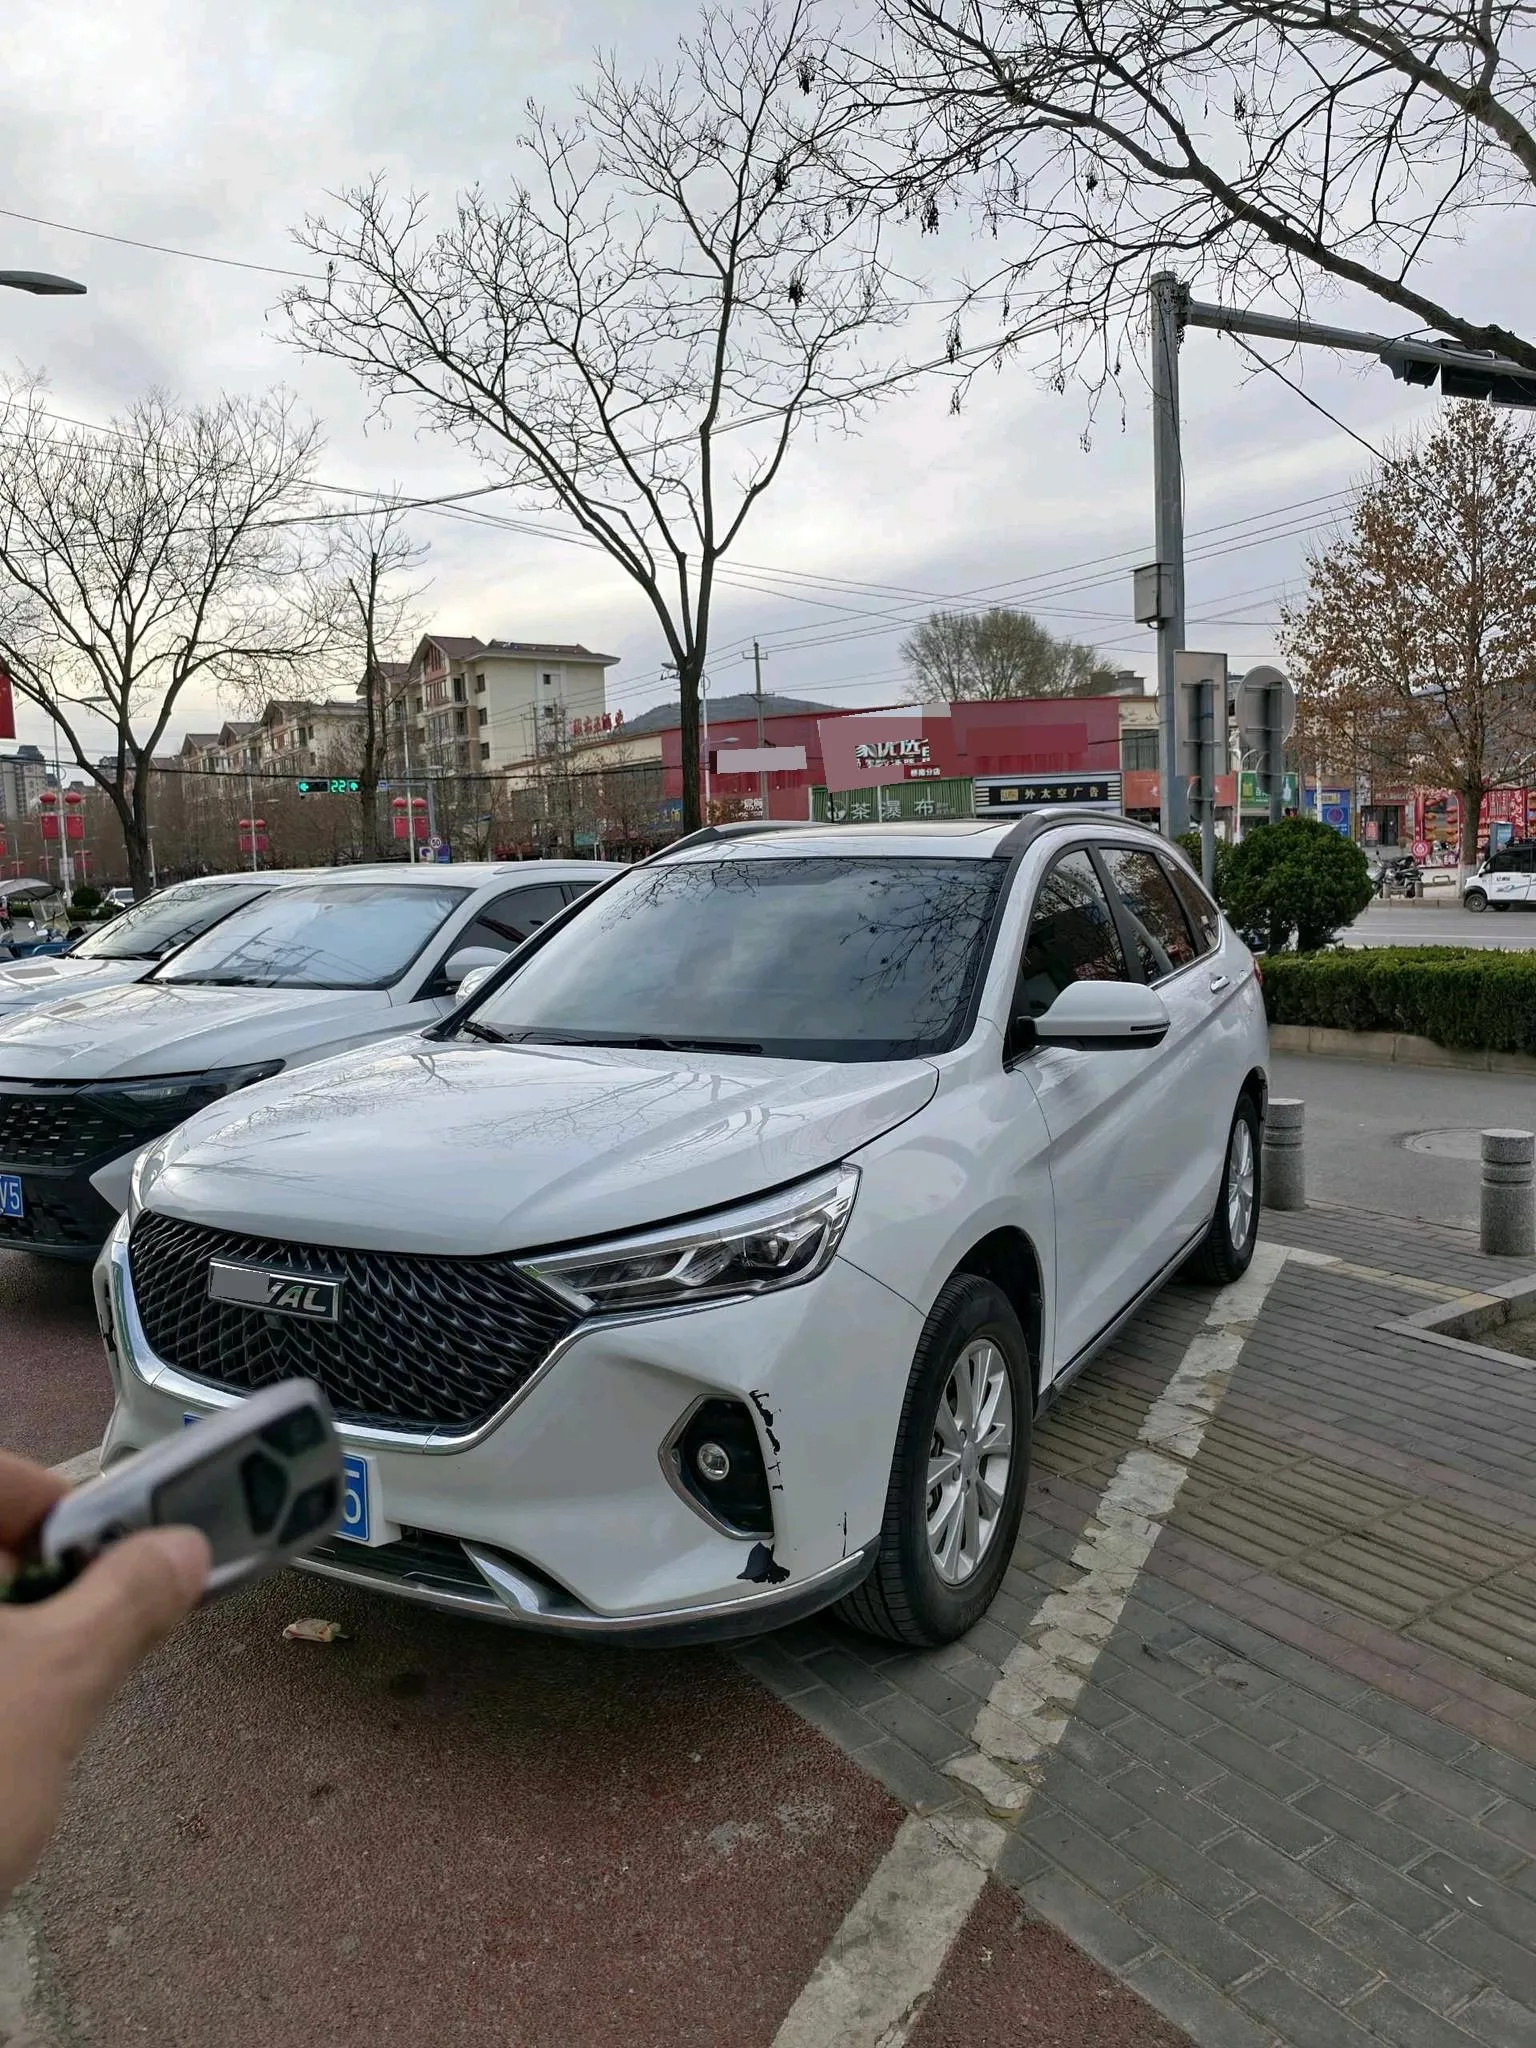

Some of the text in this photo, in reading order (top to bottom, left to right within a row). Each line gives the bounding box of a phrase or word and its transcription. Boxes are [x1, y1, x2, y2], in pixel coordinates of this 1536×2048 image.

[330, 780, 346, 793] 22
[1025, 786, 1100, 800] 外太空广告
[850, 799, 935, 820] 茶瀑布
